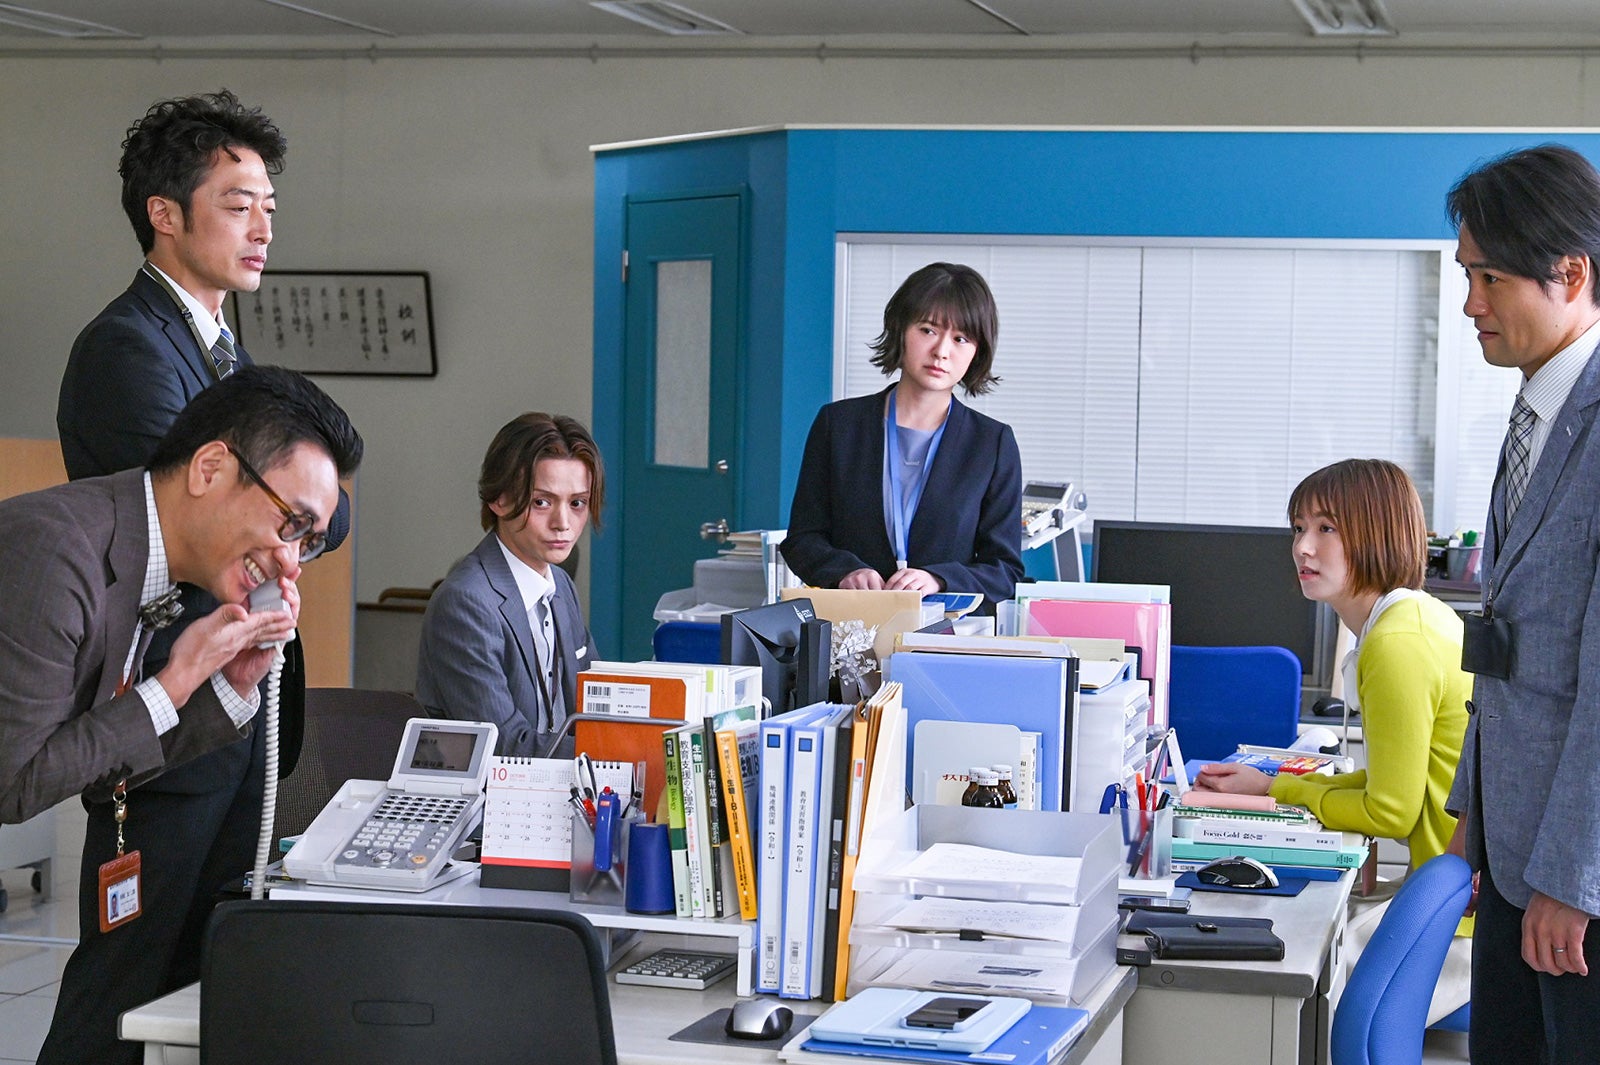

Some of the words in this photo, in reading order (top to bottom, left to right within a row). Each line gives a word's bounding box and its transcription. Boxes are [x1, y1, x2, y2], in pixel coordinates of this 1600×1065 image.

[492, 767, 508, 781] 10
[666, 760, 678, 786] 生物
[680, 740, 694, 816] 教育支援の心理学
[708, 769, 718, 807] 生物基礎
[768, 785, 776, 825] 地域連携関係
